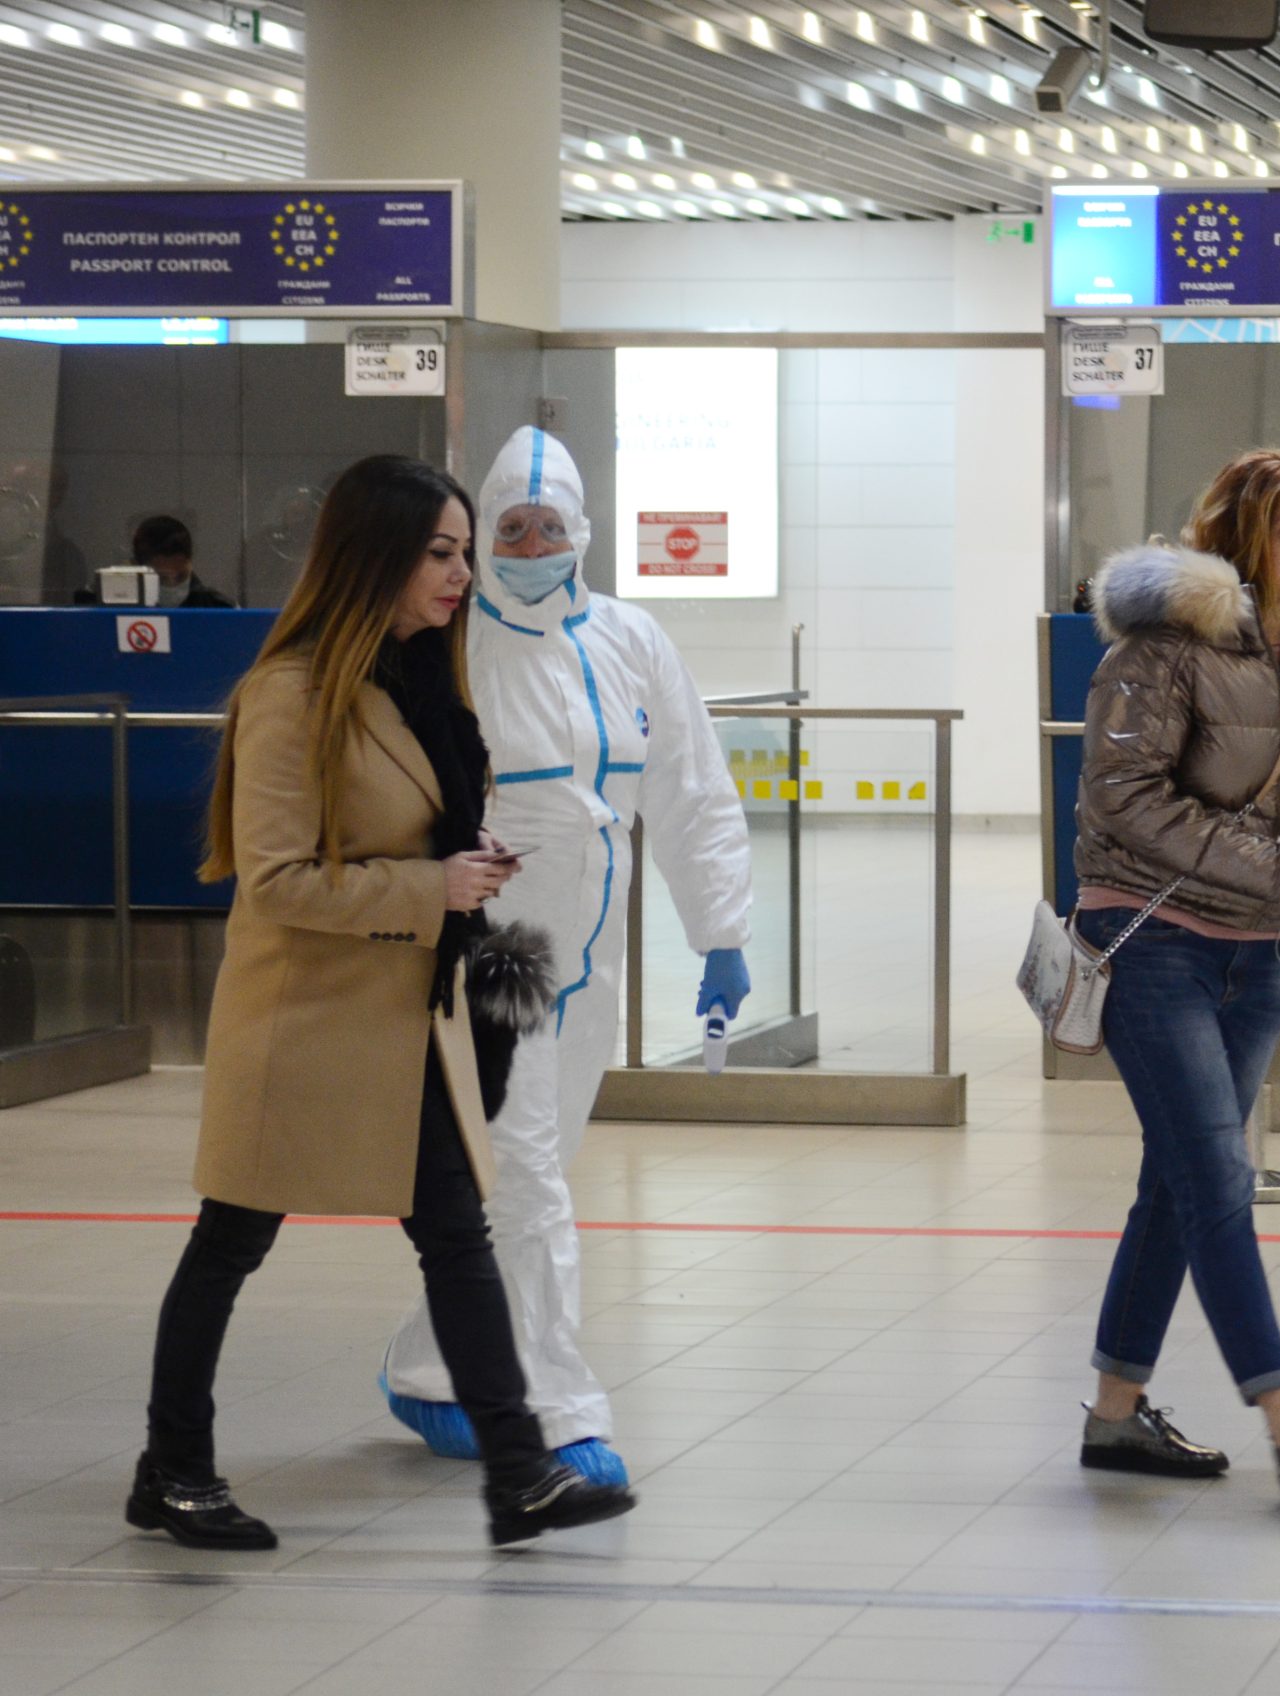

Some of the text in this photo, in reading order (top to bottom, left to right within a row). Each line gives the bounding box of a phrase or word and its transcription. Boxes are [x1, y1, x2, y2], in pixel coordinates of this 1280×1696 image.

[295, 215, 314, 227] EU
[378, 217, 430, 226] ПАСПОРТИ
[1198, 215, 1218, 227] EU
[63, 231, 241, 246] ПАСПОРТЕН КОНТРОЛ
[291, 230, 317, 242] EEA
[1193, 230, 1221, 242] EEA
[295, 245, 315, 256] CH
[1197, 245, 1218, 257] CH
[70, 258, 232, 273] PASSPORT CONTROL
[395, 276, 412, 285] ALL
[376, 292, 431, 302] PASSPORTS
[357, 357, 388, 367] DESK
[416, 349, 437, 372] 39
[1073, 357, 1105, 367] DESK
[1135, 347, 1154, 371] 37
[356, 371, 407, 381] SCHALTER
[1072, 371, 1125, 382] SCHALTER
[669, 538, 698, 550] STOP
